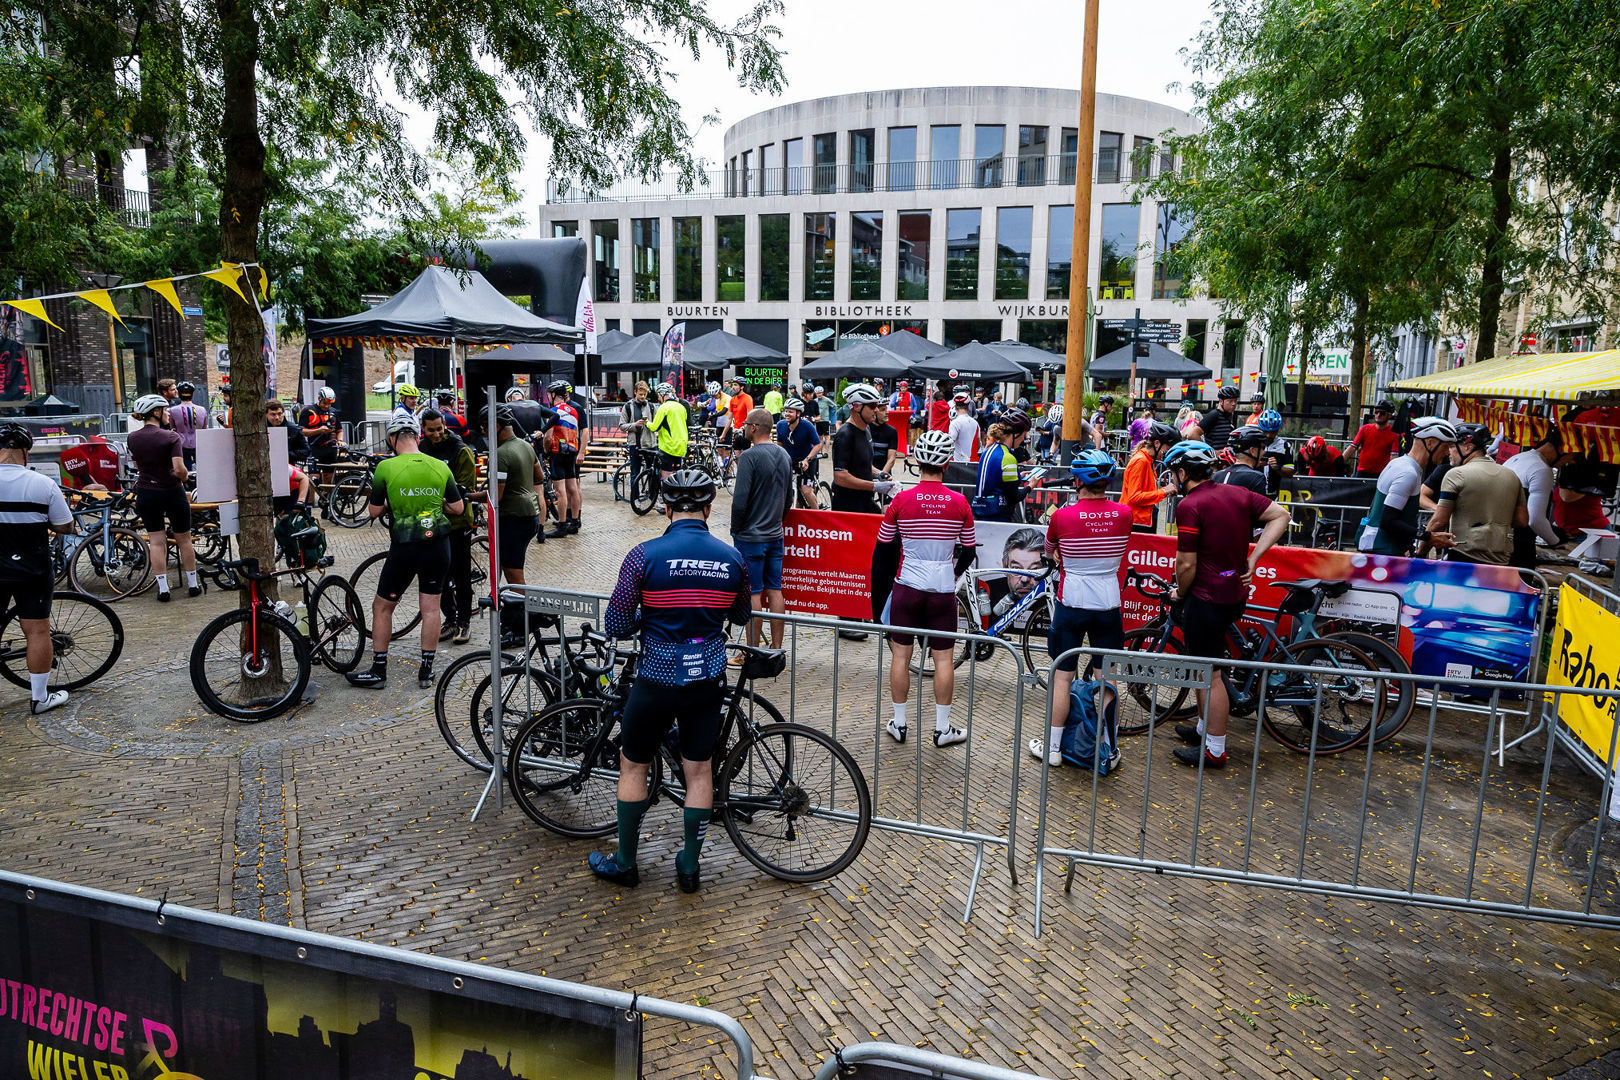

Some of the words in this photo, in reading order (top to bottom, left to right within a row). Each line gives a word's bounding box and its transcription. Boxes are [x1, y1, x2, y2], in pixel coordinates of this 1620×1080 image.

[667, 306, 729, 316] BUURTEN
[816, 306, 912, 316] BIBLIOTHEEK
[998, 306, 1104, 318] WIJKBURU
[745, 368, 782, 376] BUURTEN
[400, 488, 440, 496] KASKON
[782, 527, 793, 536] n
[798, 524, 853, 541] Rossem
[784, 544, 820, 558] rtelt!
[666, 559, 730, 572] TREK
[783, 568, 817, 576] programma
[839, 572, 866, 580] Maarten
[797, 584, 815, 592] tijden.
[817, 586, 835, 594] Bekijk
[819, 579, 866, 588] gebeurtenissen
[529, 596, 593, 614] HANSWIJK
[994, 584, 1039, 630] RIDLEY
[1124, 601, 1141, 611] Blijf
[1142, 604, 1154, 612] op
[1110, 662, 1205, 683] HANSWIJK
[1559, 628, 1609, 709] Rabo
